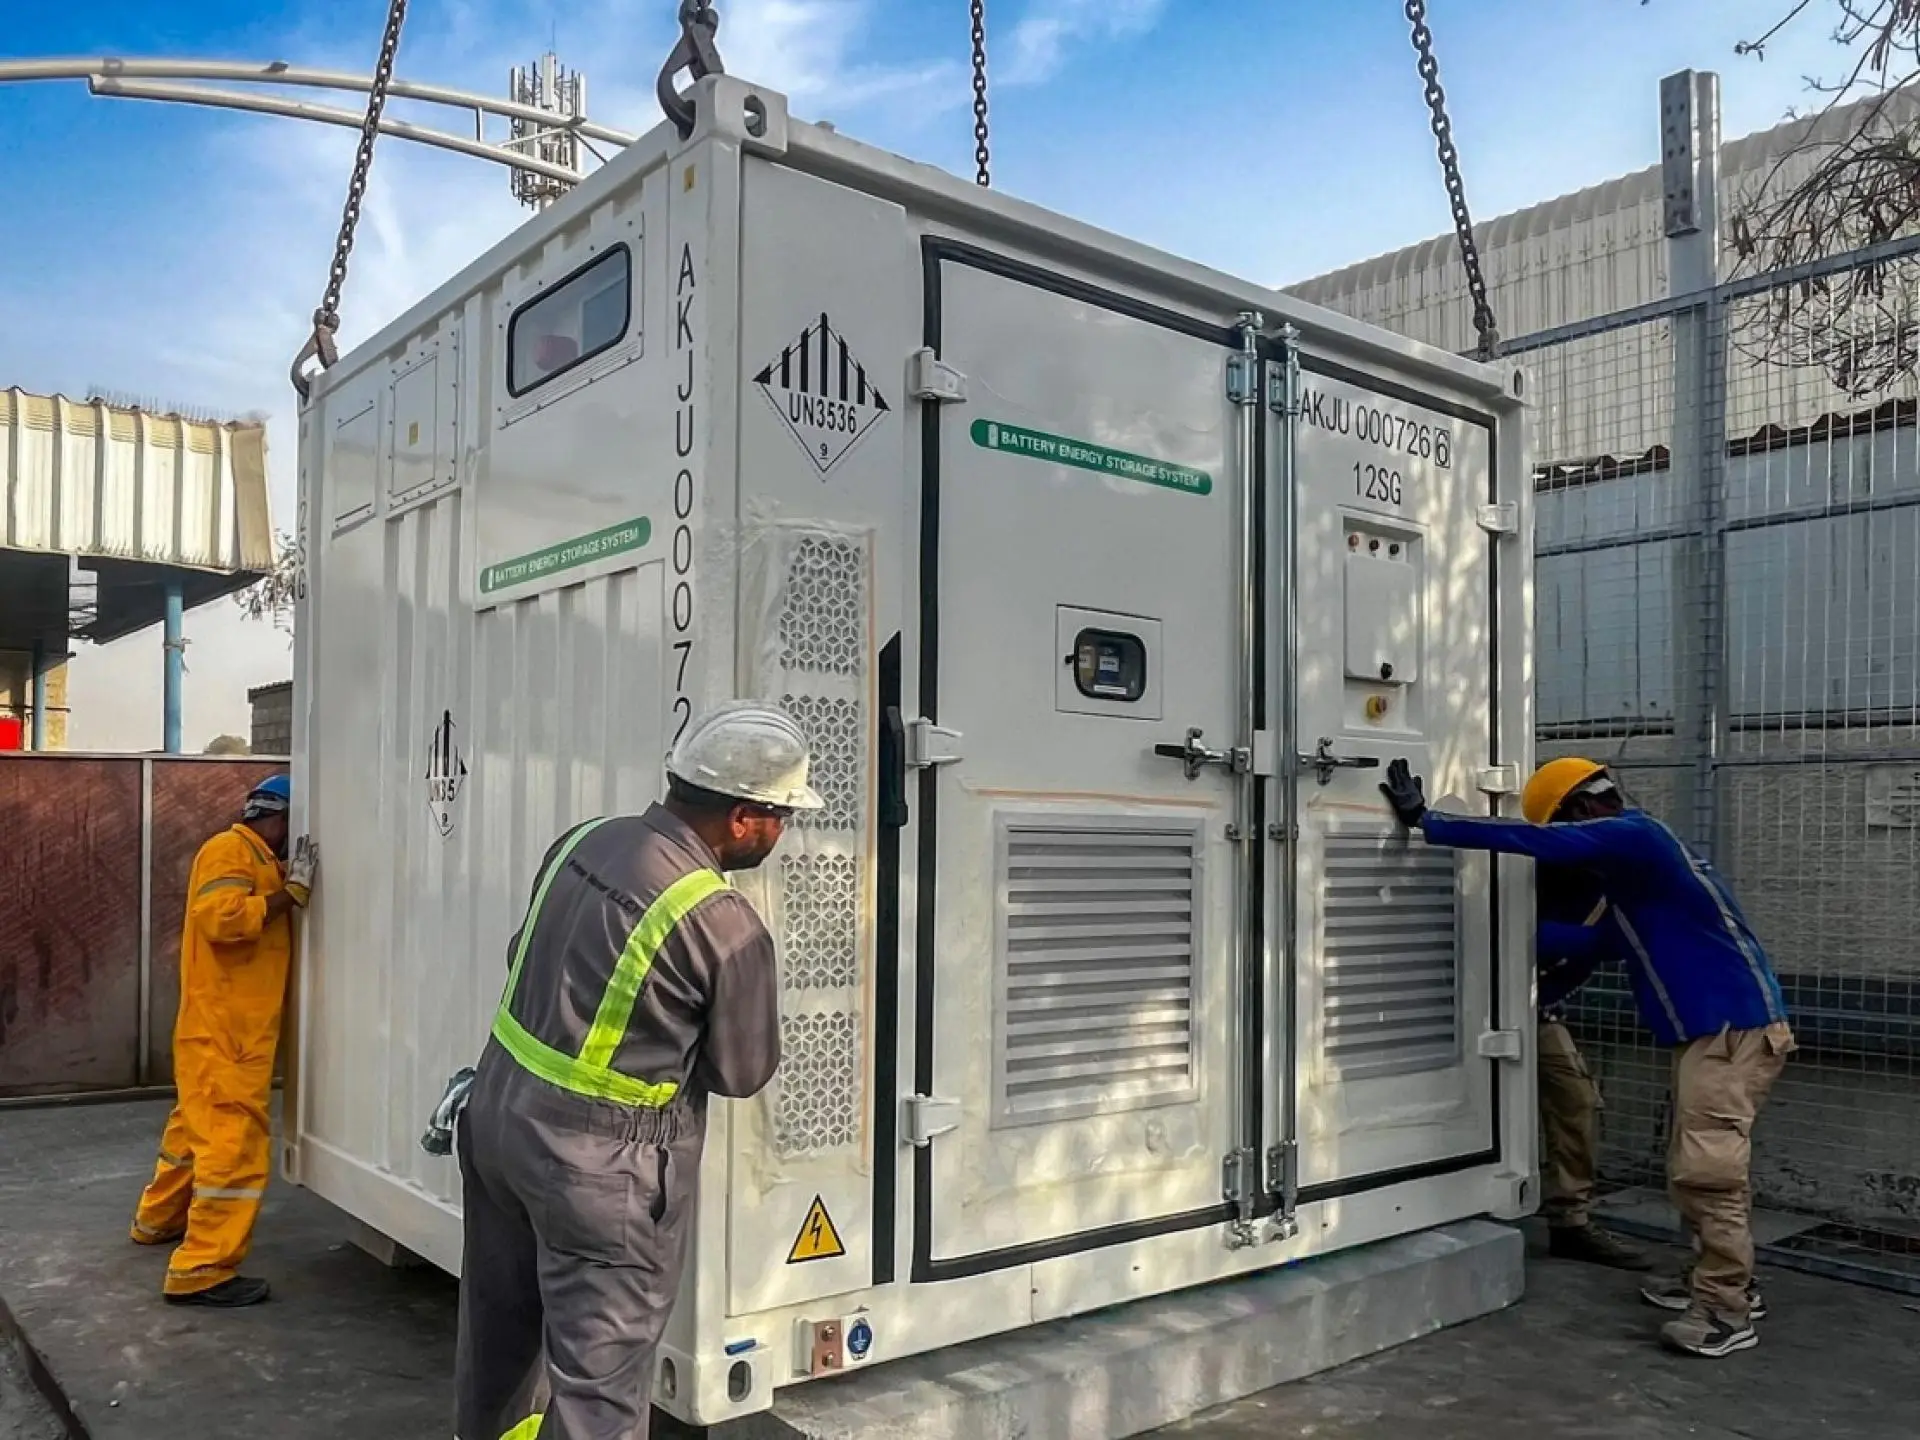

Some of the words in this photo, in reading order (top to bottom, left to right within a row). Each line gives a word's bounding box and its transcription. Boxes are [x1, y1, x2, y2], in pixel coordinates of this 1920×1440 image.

[676, 242, 695, 458] AKJU
[788, 392, 857, 434] UN3536
[1300, 387, 1350, 434] AKJU
[1356, 405, 1431, 459] 000726
[1436, 430, 1449, 466] 6
[819, 443, 828, 459] 9
[1001, 431, 1055, 453] BATTERY
[1059, 444, 1104, 465] ENERGY
[1106, 455, 1157, 479] STORAGE
[1158, 467, 1200, 488] SYSTEM
[1353, 461, 1401, 505] 12SG
[495, 564, 526, 583] BATTERY
[529, 552, 559, 573] ENERGY
[561, 540, 600, 564] STORAGE
[601, 527, 639, 550] SYSTEM
